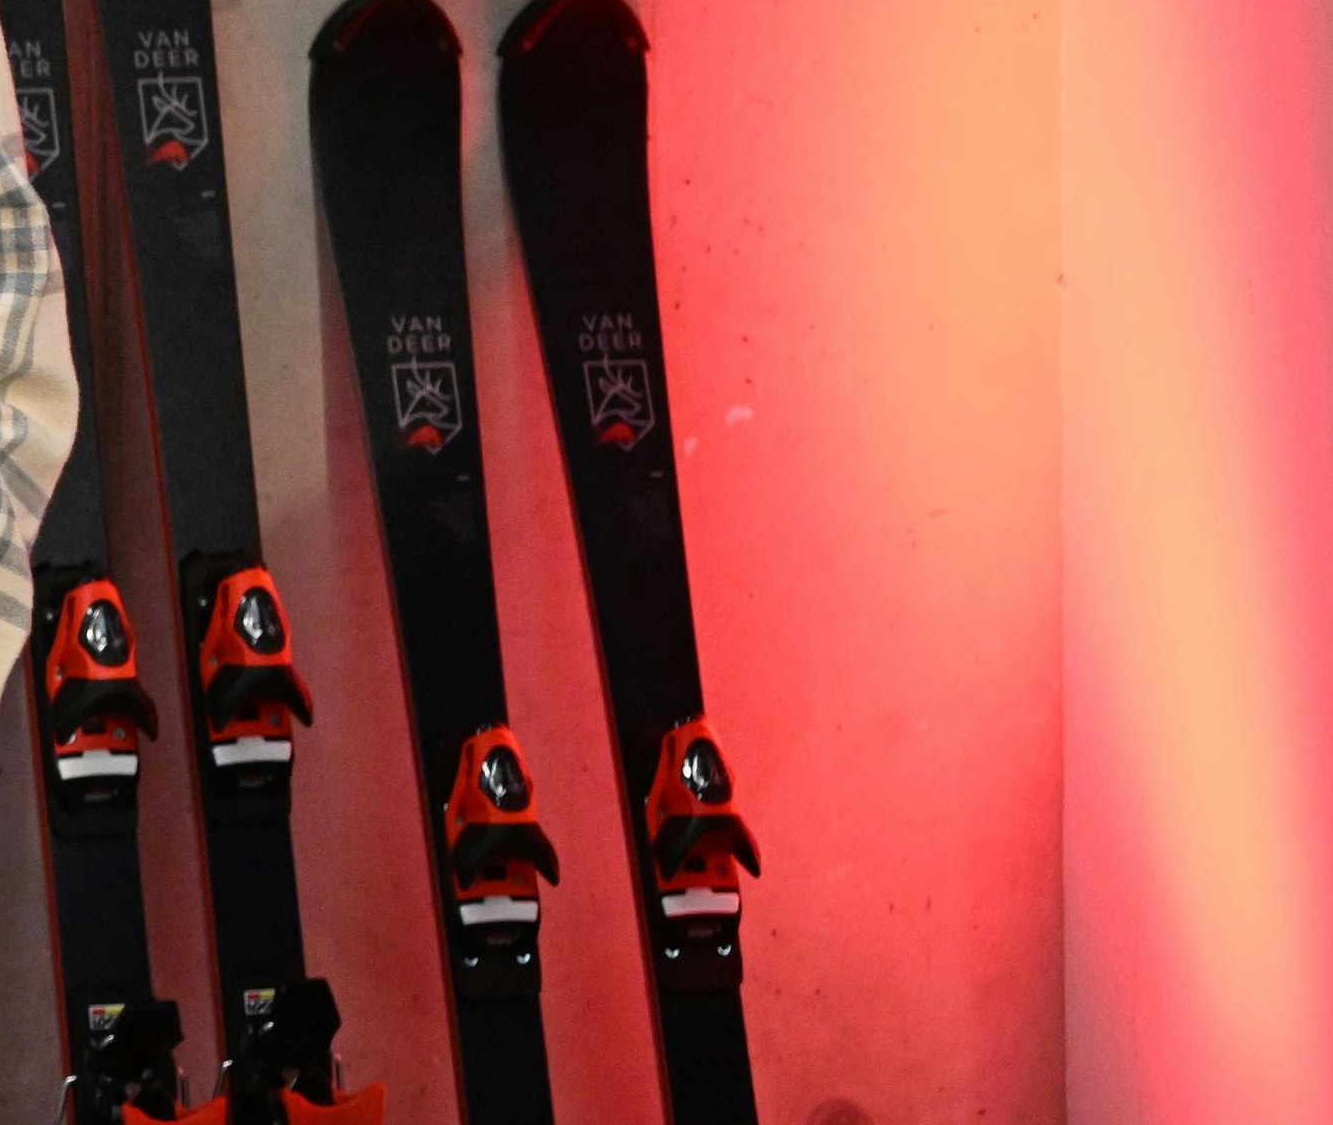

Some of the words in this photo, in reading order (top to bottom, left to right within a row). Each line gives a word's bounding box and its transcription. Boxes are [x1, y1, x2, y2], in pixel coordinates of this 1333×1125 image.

[8, 39, 42, 59] AN
[137, 29, 190, 49] VAN
[133, 49, 200, 69] DEER
[390, 314, 443, 333] VAN
[582, 313, 633, 331] VAN
[387, 333, 452, 354] DEER
[578, 332, 643, 353] DEER
